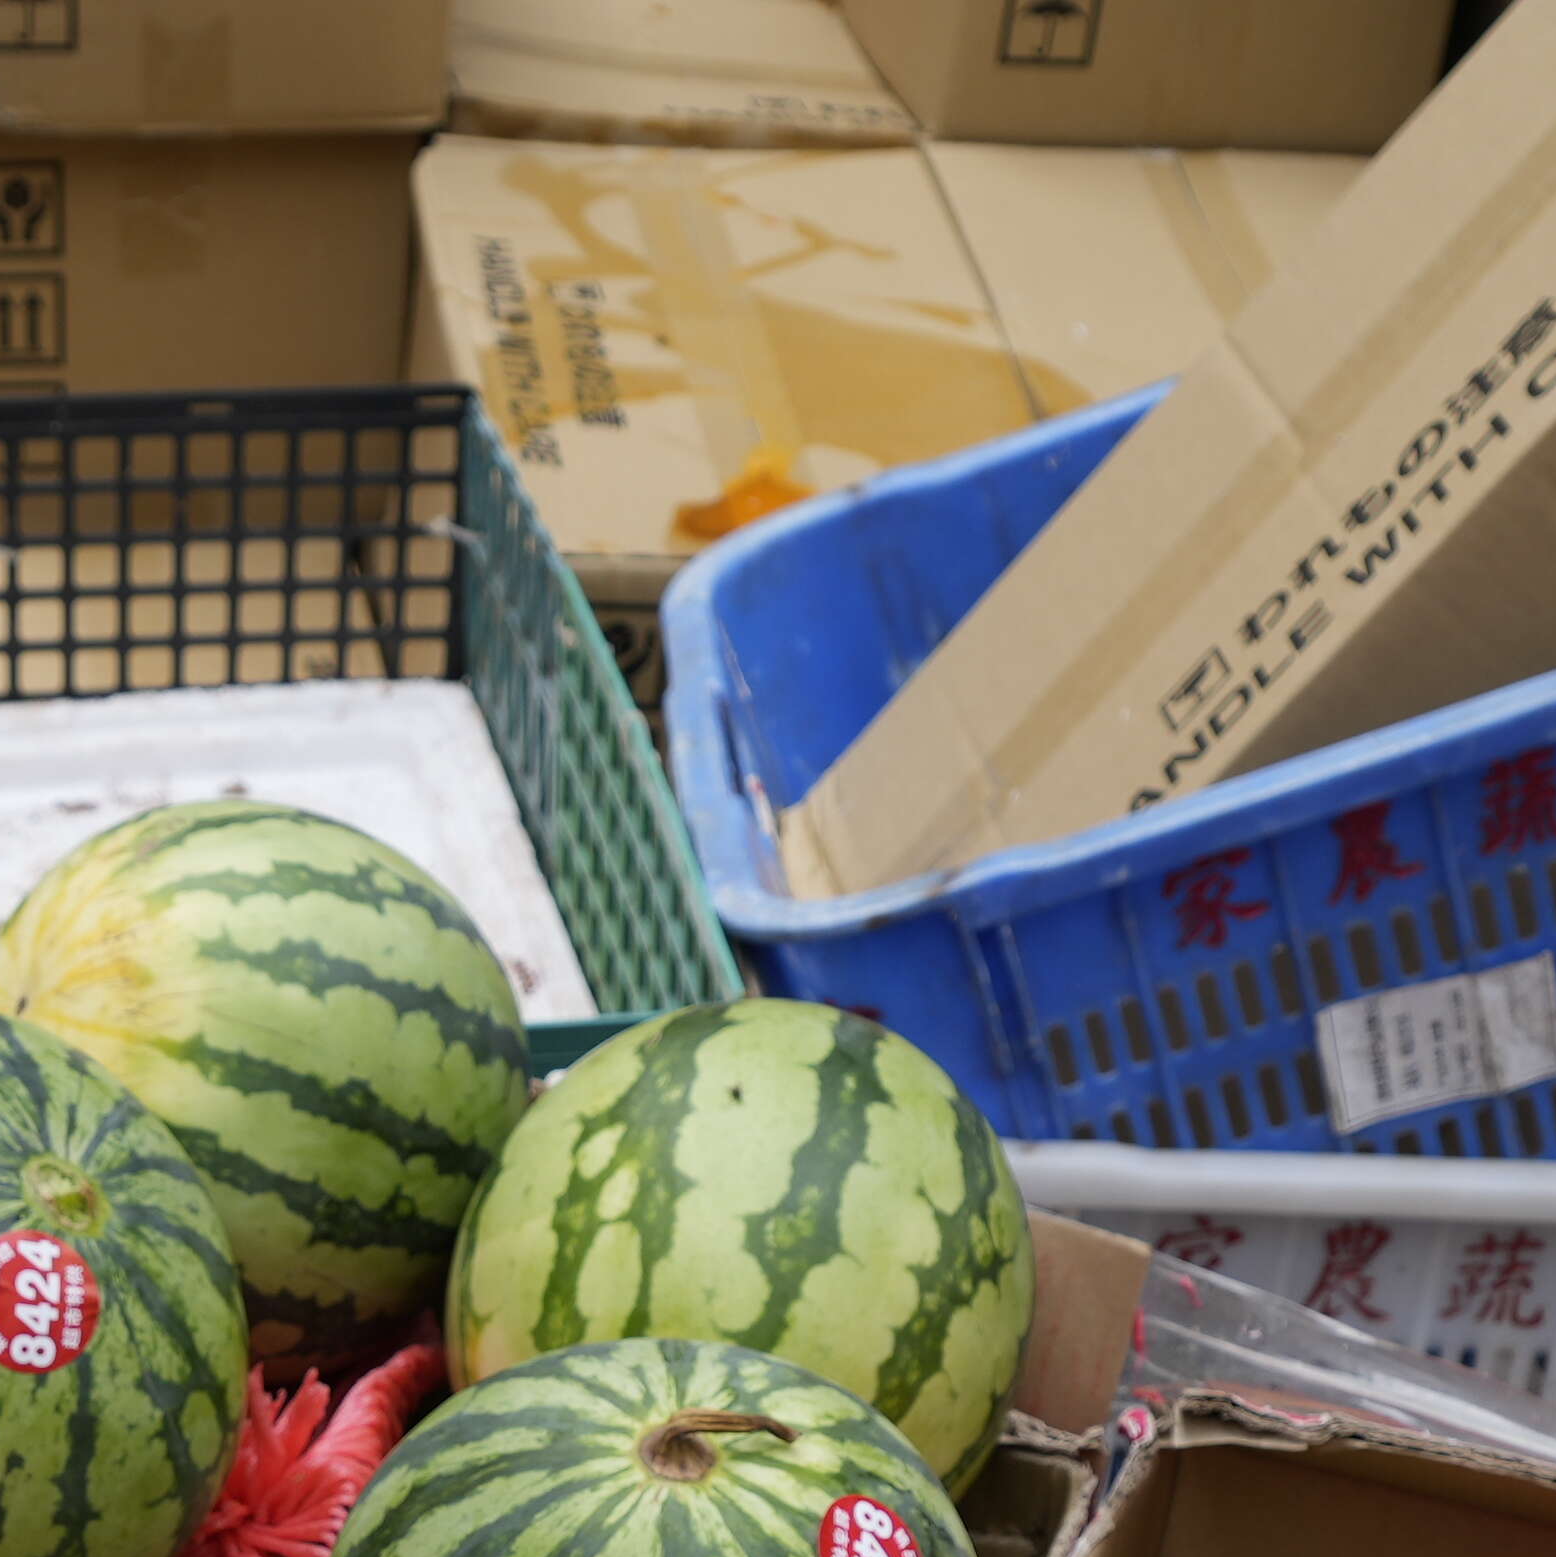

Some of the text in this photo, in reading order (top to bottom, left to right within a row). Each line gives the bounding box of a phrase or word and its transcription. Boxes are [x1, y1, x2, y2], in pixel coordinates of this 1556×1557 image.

[1126, 602, 1334, 815] ANDLE
[1345, 403, 1512, 590] WITH
[8, 1238, 63, 1370] 8424
